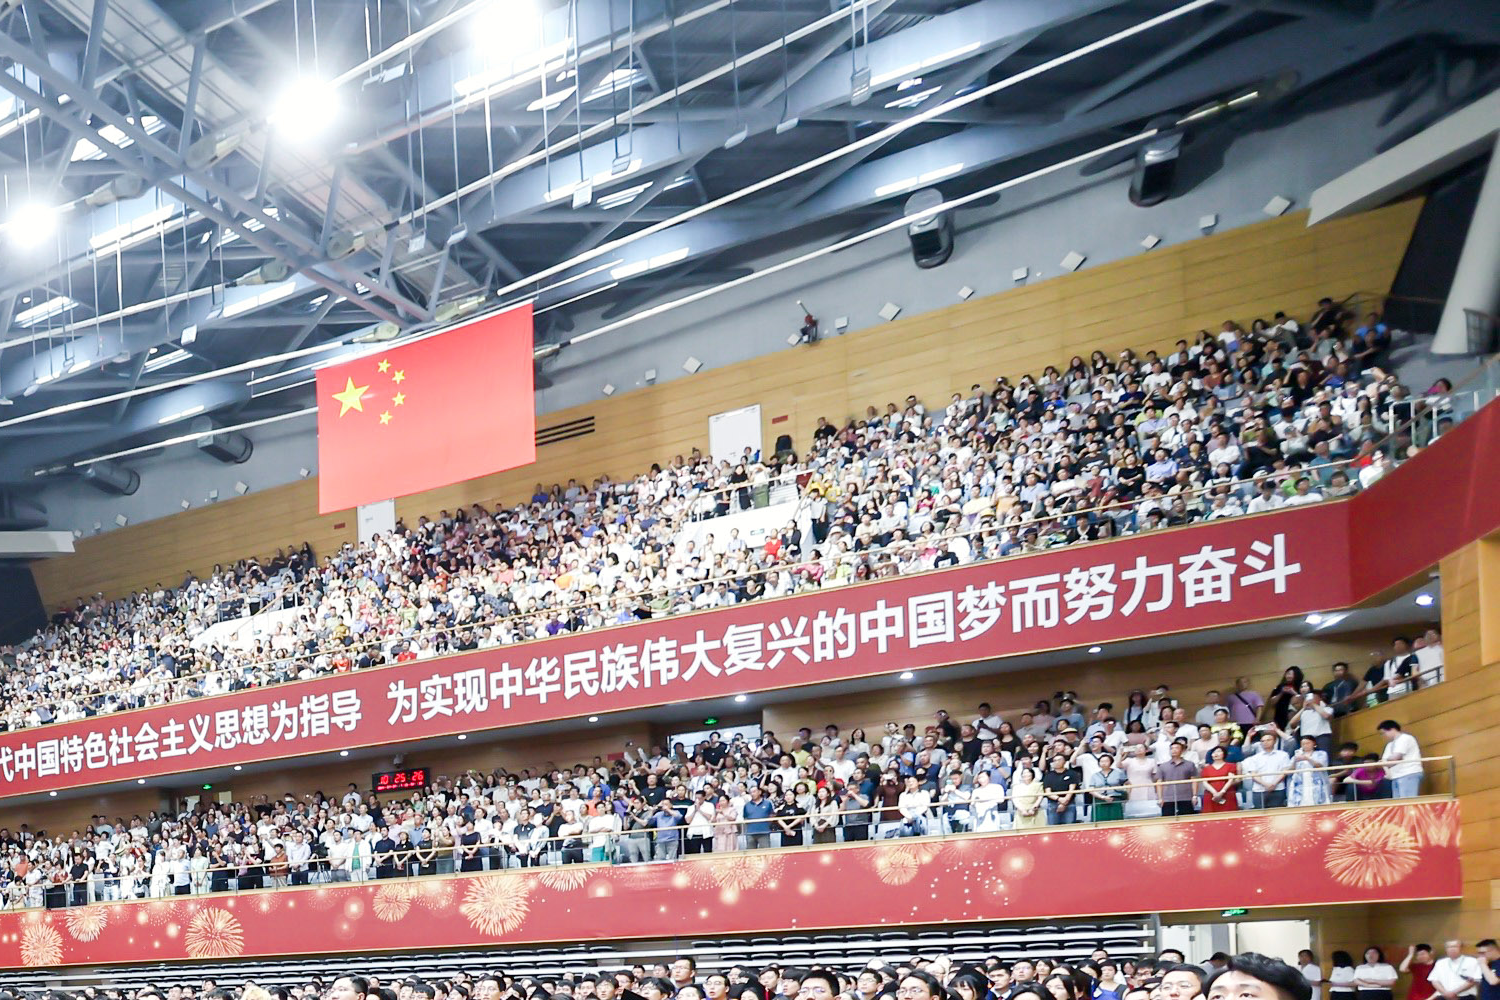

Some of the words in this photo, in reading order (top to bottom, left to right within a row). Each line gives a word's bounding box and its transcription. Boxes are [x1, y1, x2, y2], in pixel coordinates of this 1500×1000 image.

[387, 533, 1301, 726] 为实现中华民族伟大复兴的中国梦而努力奋斗
